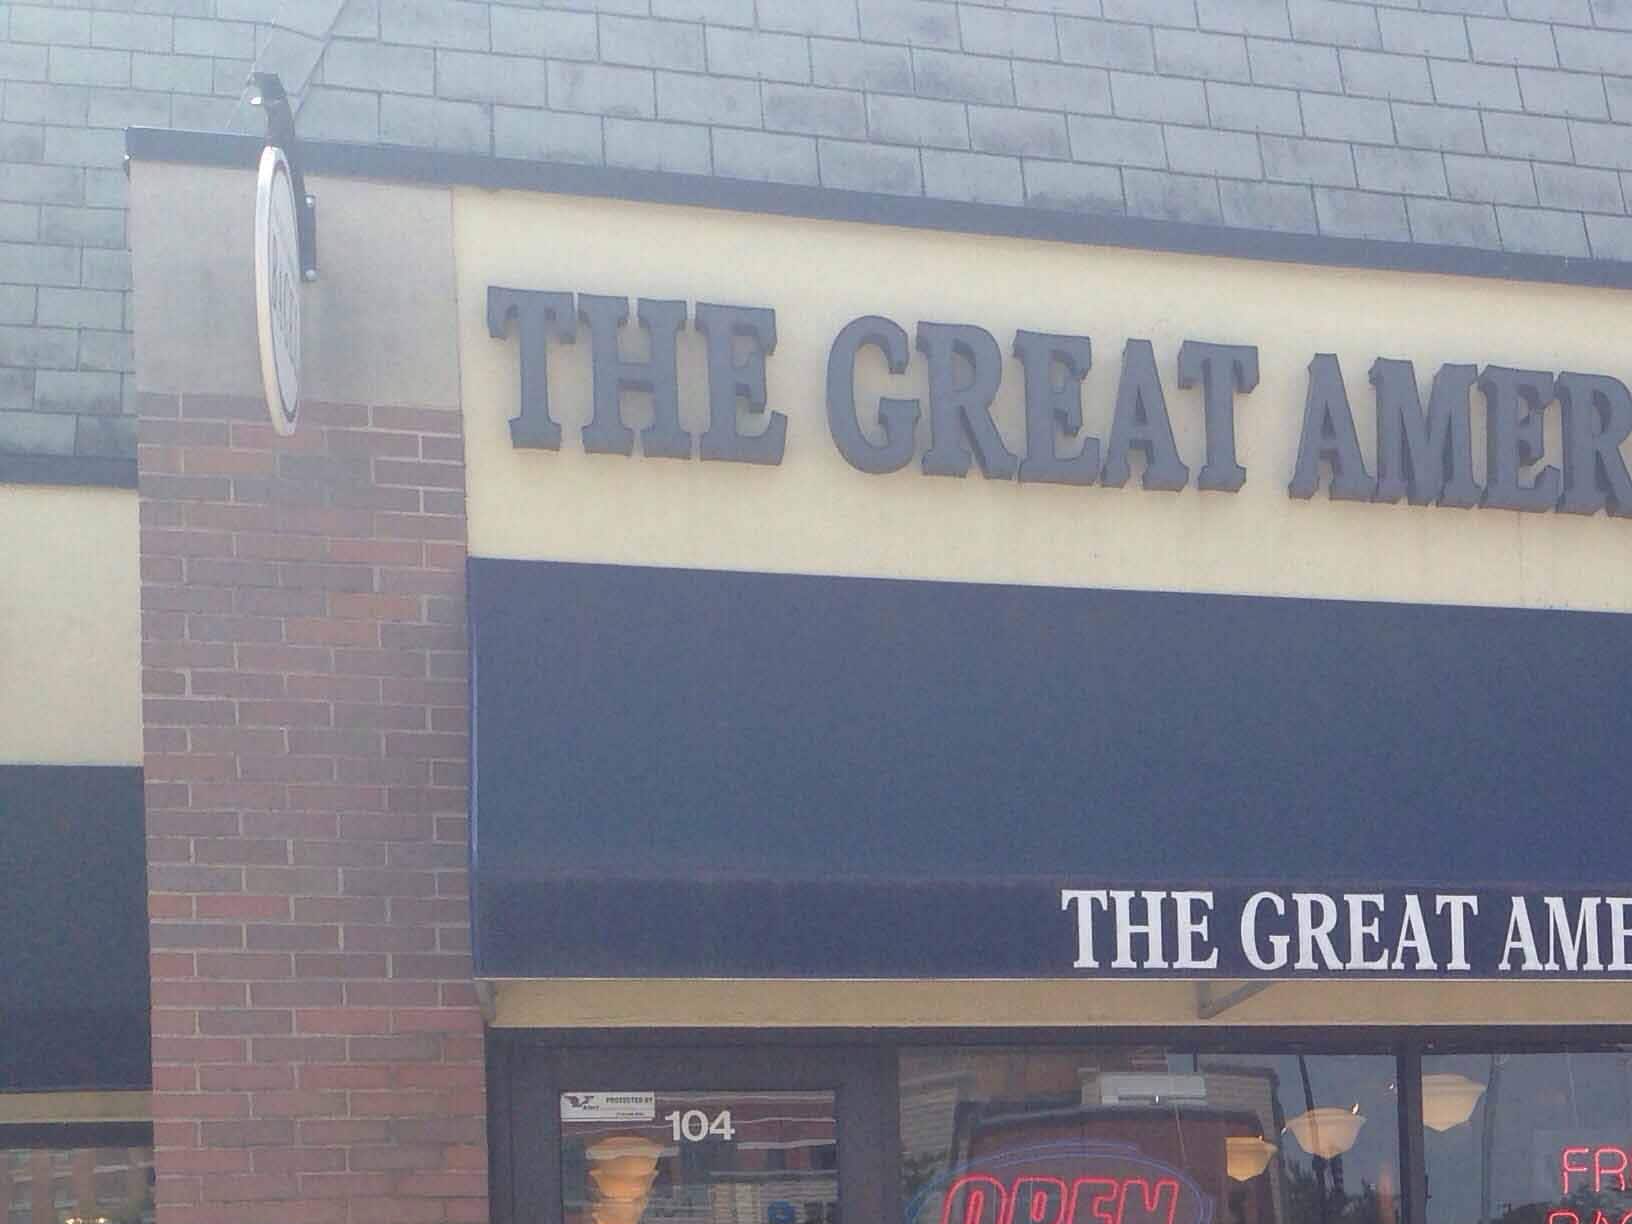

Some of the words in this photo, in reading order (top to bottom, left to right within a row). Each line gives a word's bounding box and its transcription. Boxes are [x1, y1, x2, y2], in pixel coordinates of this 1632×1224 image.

[486, 285, 787, 466] THE
[826, 315, 1259, 494] GREAT
[1061, 888, 1218, 970] THE
[1240, 891, 1478, 972] GREAT
[665, 1109, 735, 1142] 104
